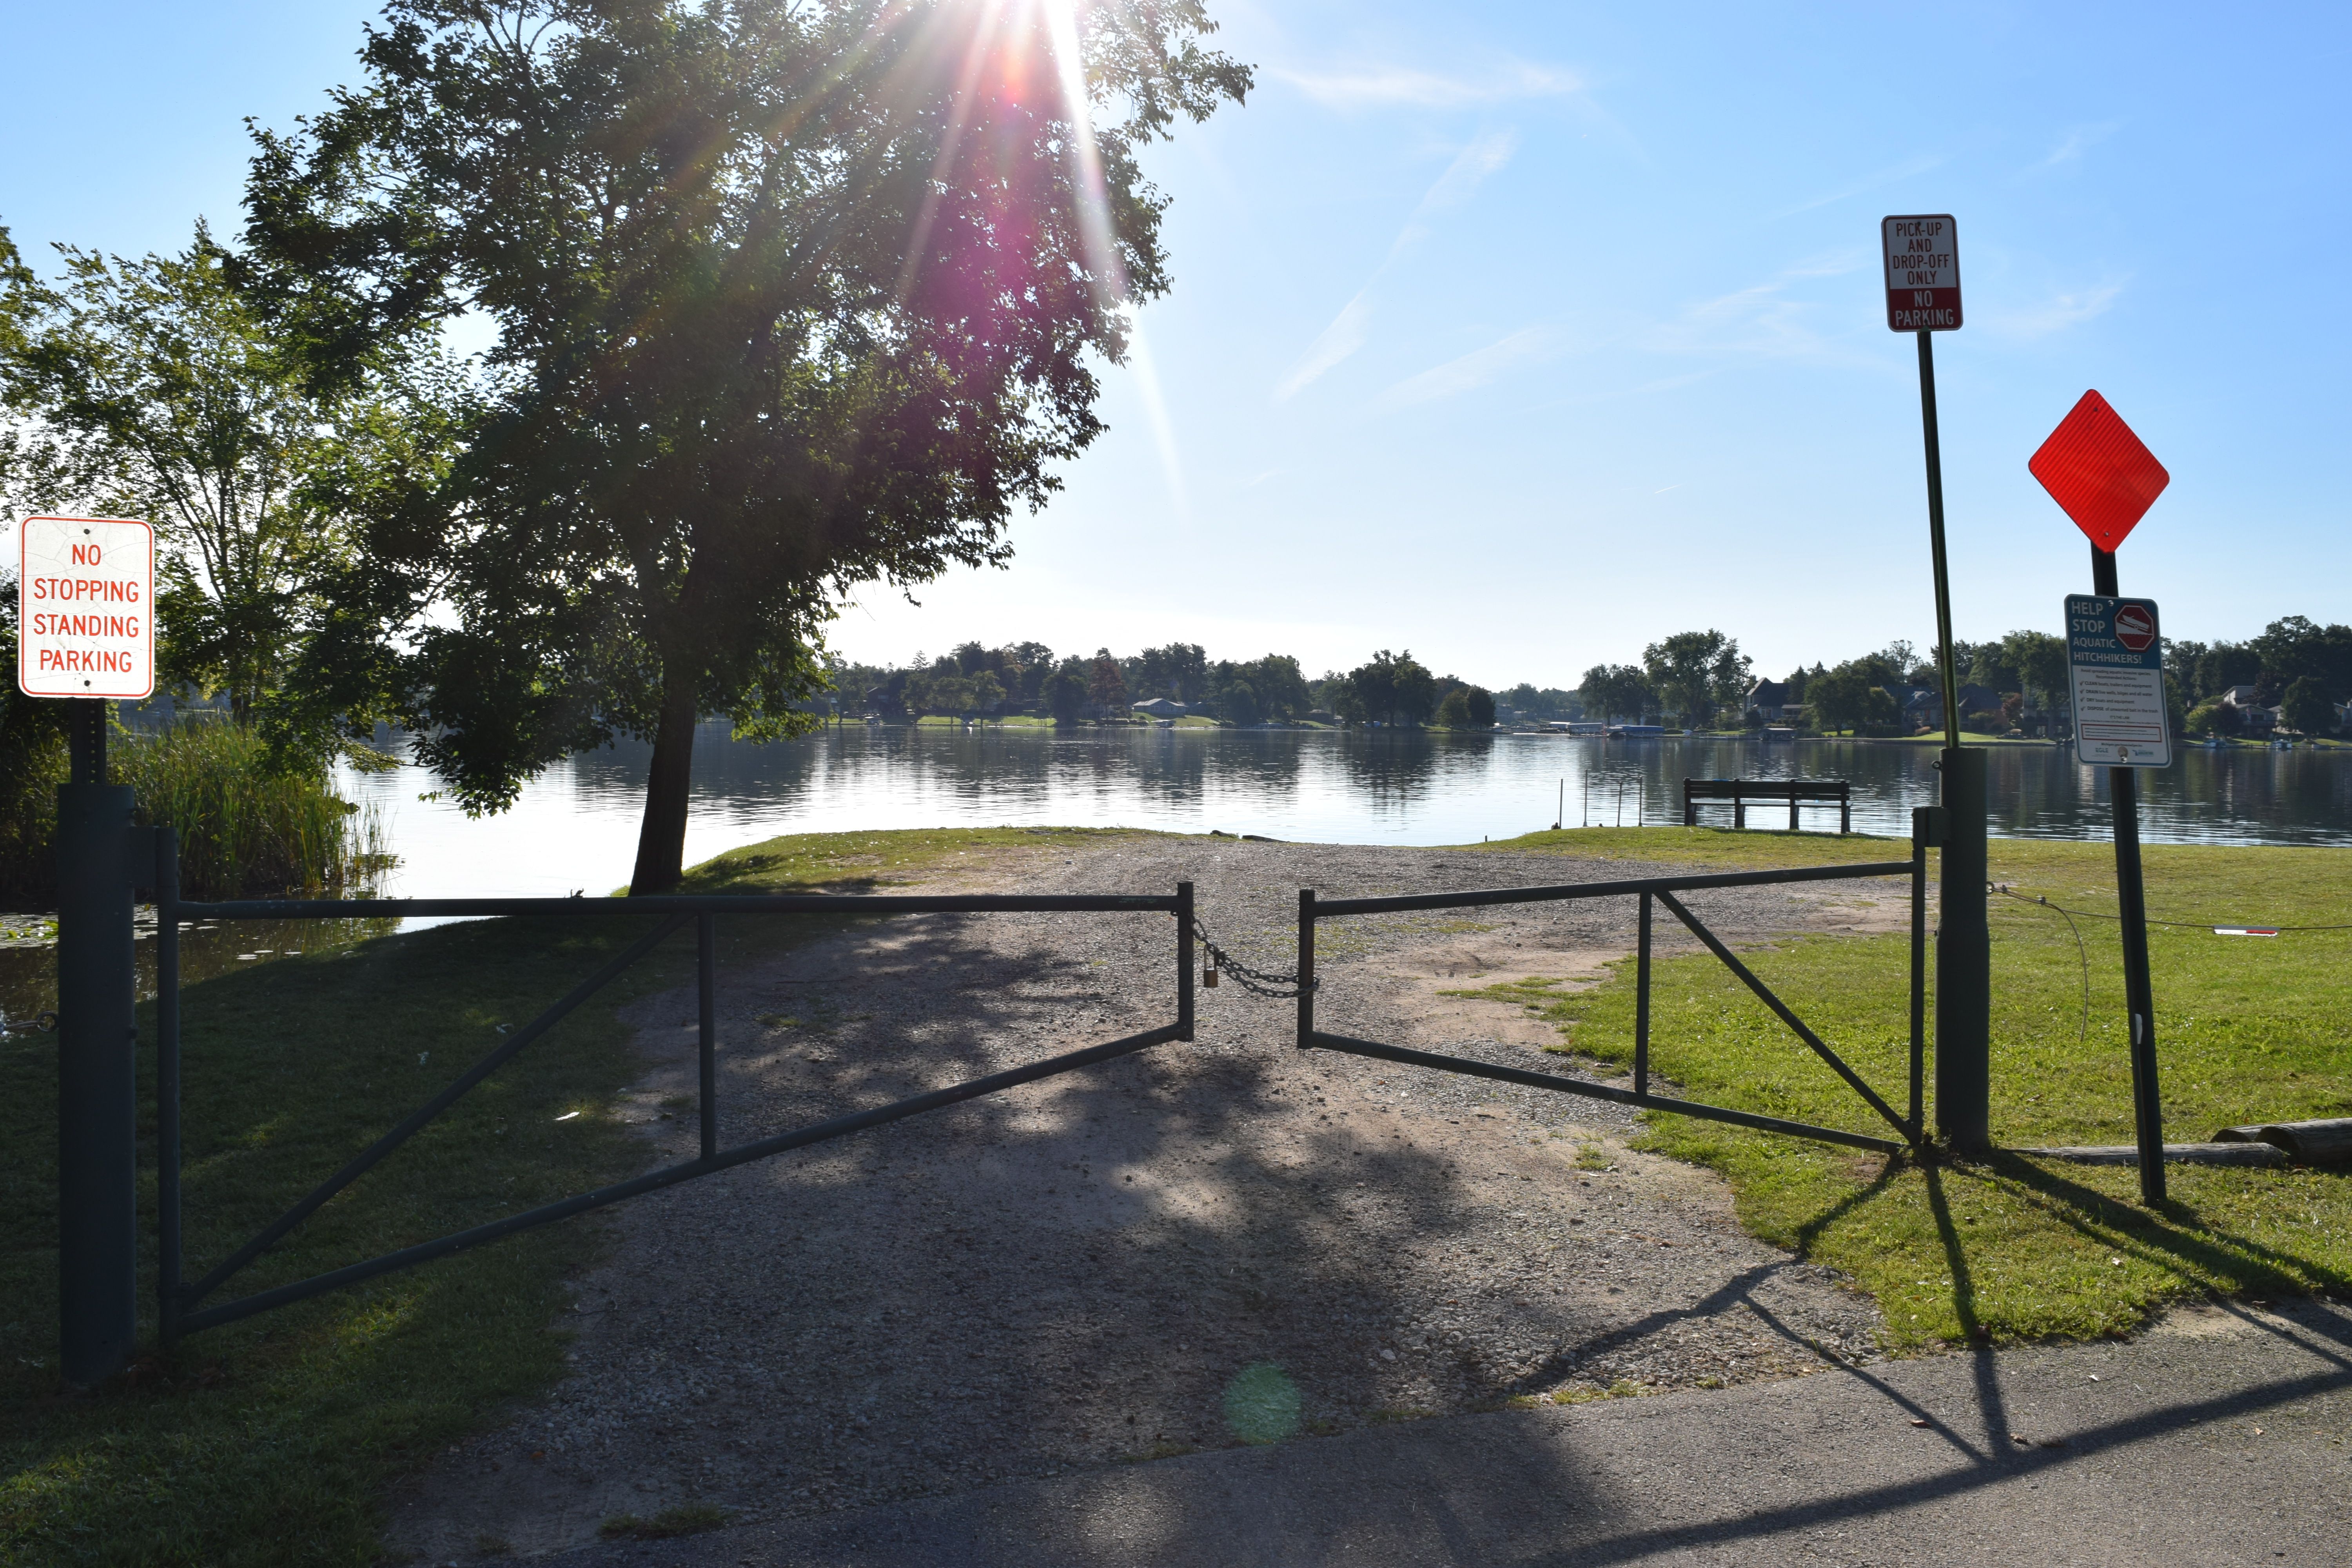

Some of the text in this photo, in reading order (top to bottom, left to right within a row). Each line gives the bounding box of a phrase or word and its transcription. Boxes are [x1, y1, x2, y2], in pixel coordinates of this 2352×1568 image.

[1896, 222, 1942, 237] PICK-UP
[1908, 238, 1932, 252] AND
[1893, 254, 1949, 269] DROP-OFF
[1907, 270, 1937, 285] ONLY
[1914, 290, 1933, 307] NO
[1895, 309, 1954, 326] PARKING
[72, 544, 101, 566] NO
[34, 578, 138, 603] STOPPING
[2072, 601, 2103, 615] HELP
[34, 613, 138, 638] STANDING
[2073, 619, 2105, 633] STOP
[2073, 637, 2116, 648] AQUATIC
[40, 650, 132, 673] PARKING
[2074, 652, 2142, 664] HITCHHIKERS!
